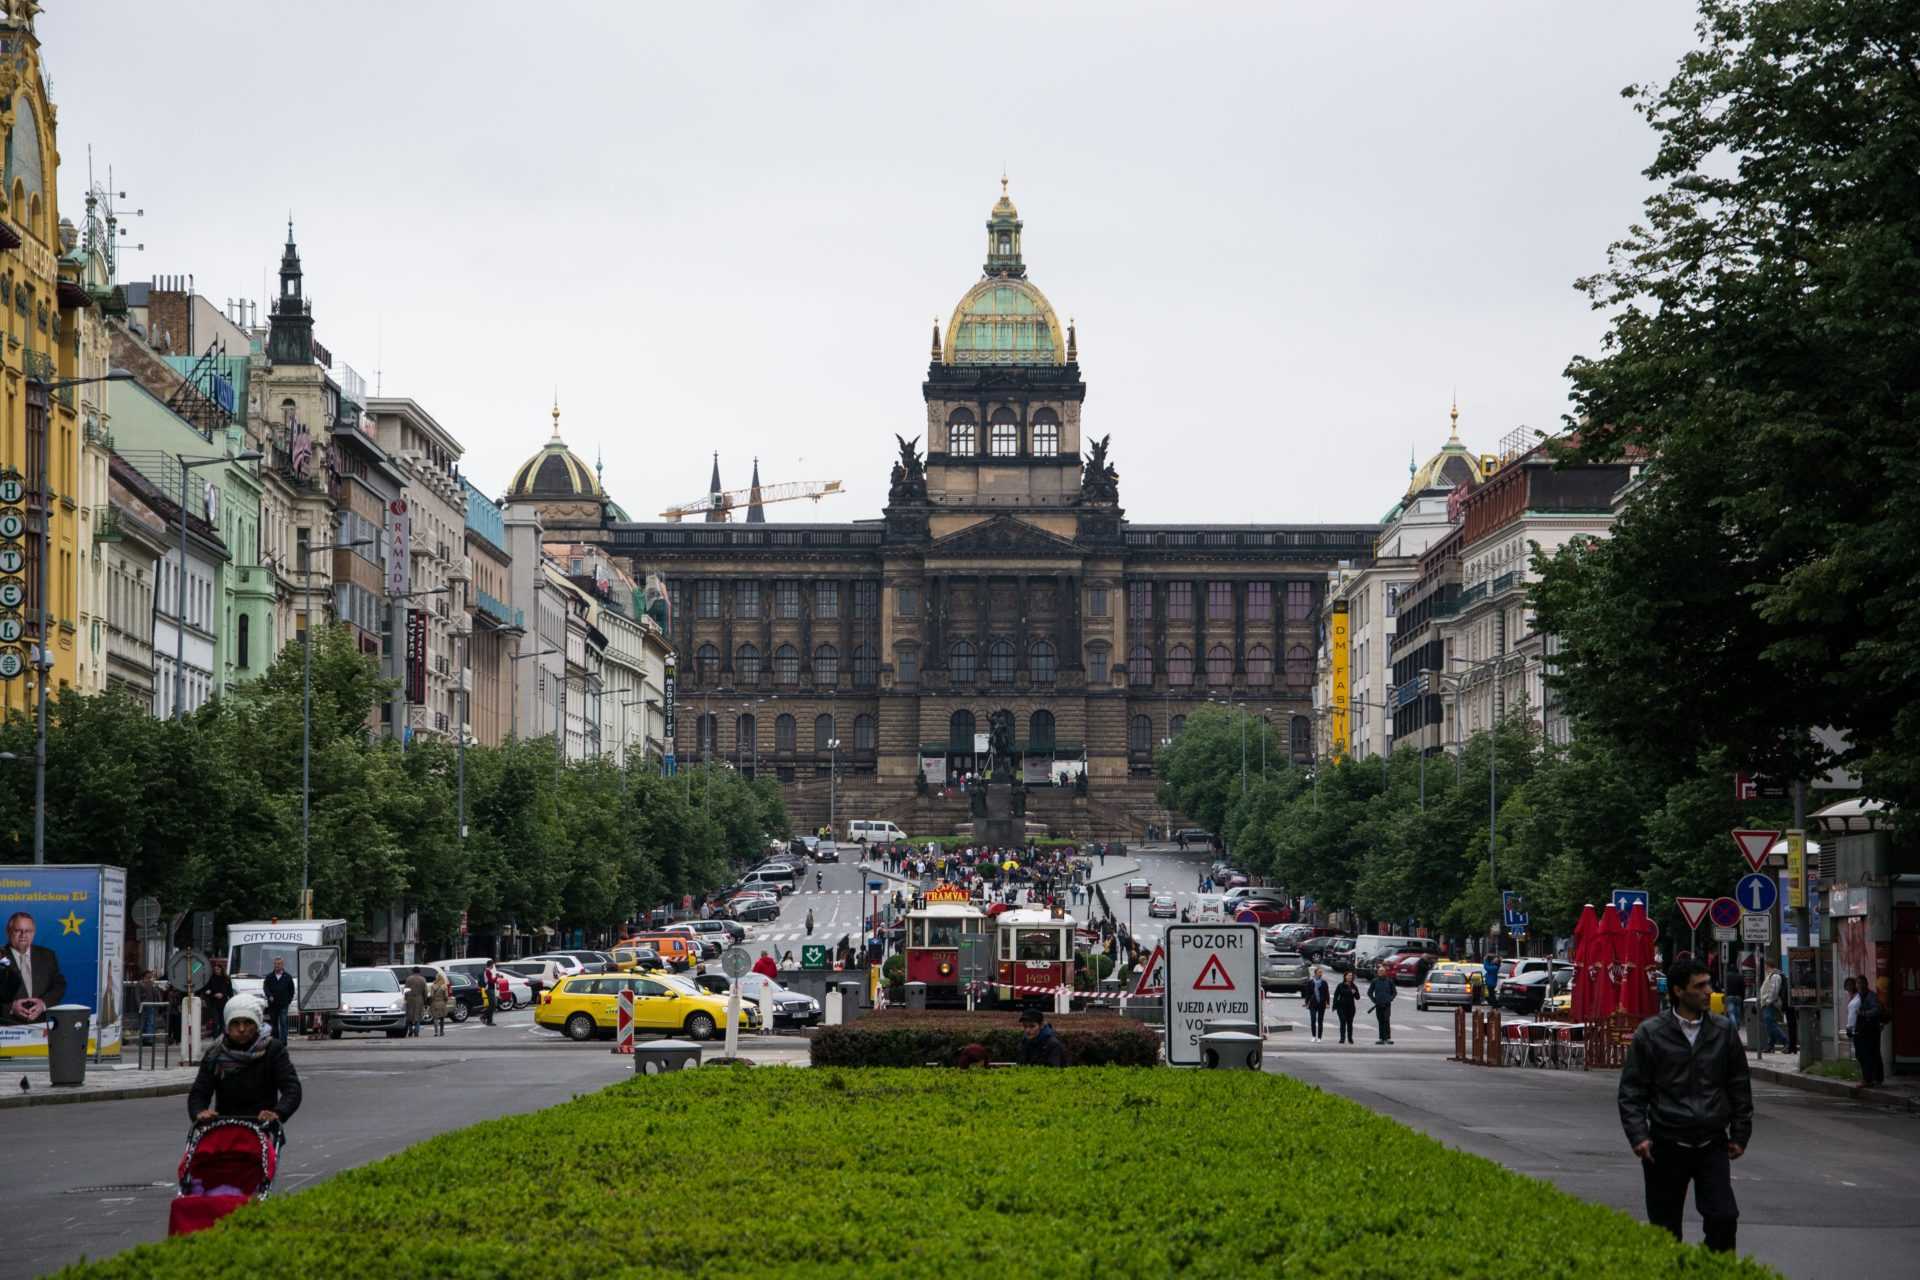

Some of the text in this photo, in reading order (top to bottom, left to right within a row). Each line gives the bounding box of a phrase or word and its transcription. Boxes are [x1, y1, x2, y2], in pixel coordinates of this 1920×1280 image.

[3, 482, 17, 639] HOTEL
[71, 890, 88, 901] EU
[926, 891, 969, 901] TRAMVAJ
[243, 931, 303, 943] CITY TOURS
[1182, 934, 1244, 950] POZOR!
[1177, 999, 1249, 1014] VJEZD A VÝJEZD
